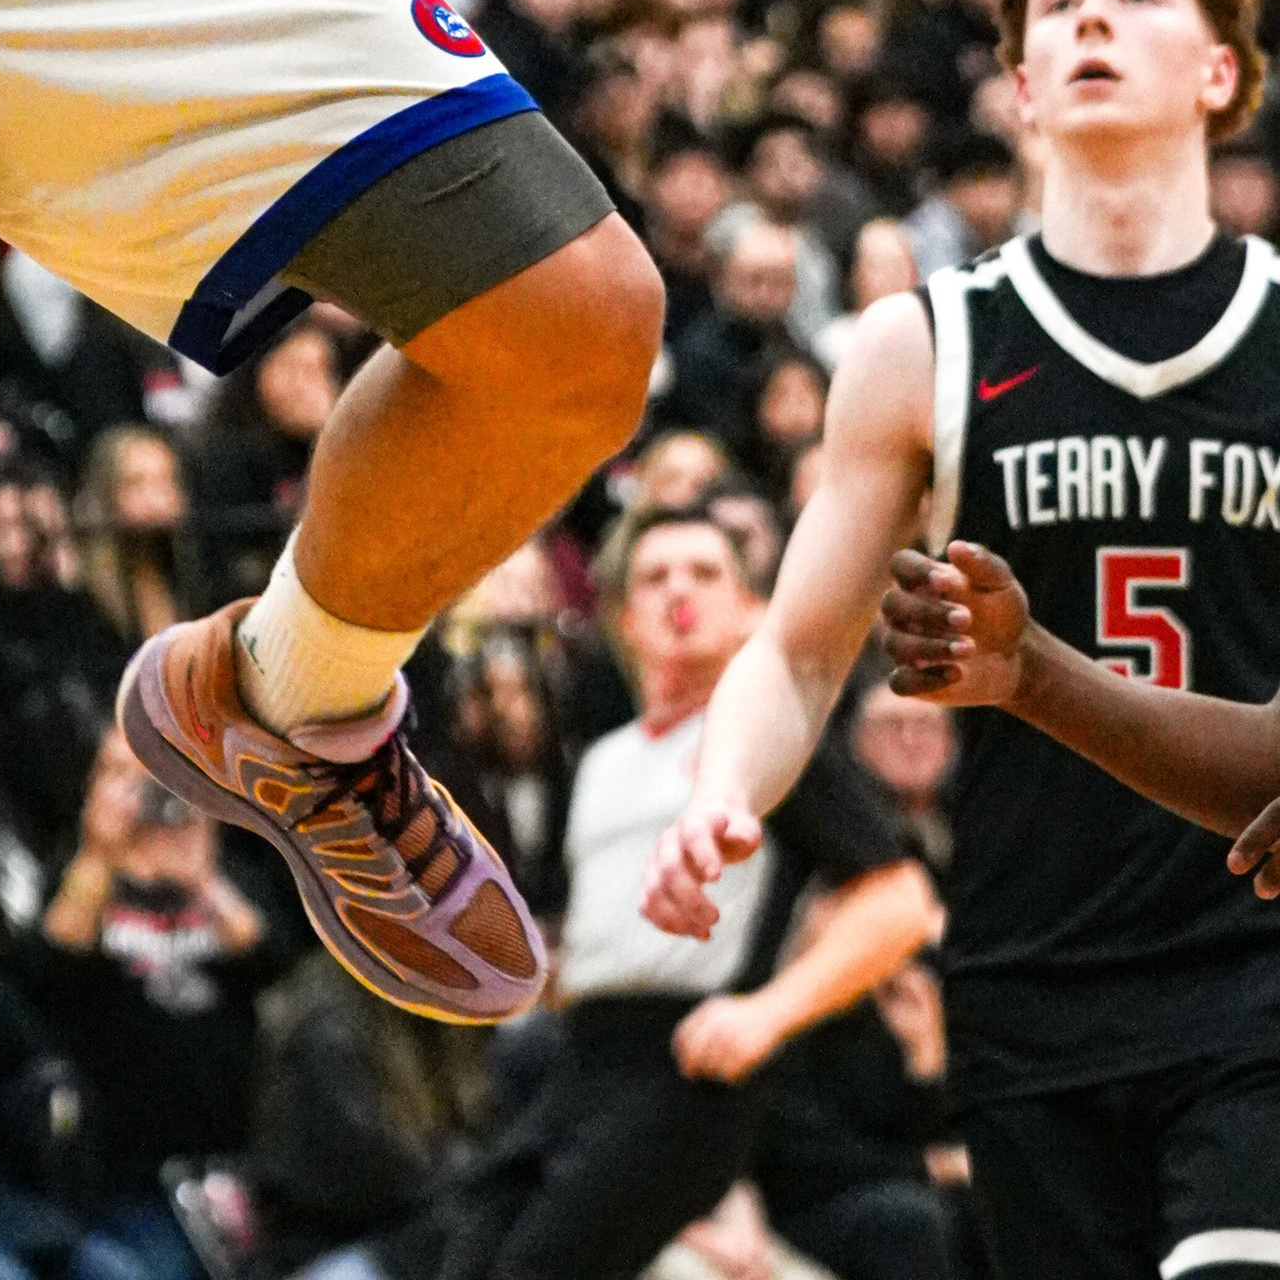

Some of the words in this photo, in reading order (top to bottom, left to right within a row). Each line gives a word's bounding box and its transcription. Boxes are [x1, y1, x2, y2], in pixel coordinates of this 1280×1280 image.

[992, 434, 1168, 530] TERRY
[1188, 438, 1280, 532] FOX
[1095, 545, 1190, 691] 5
